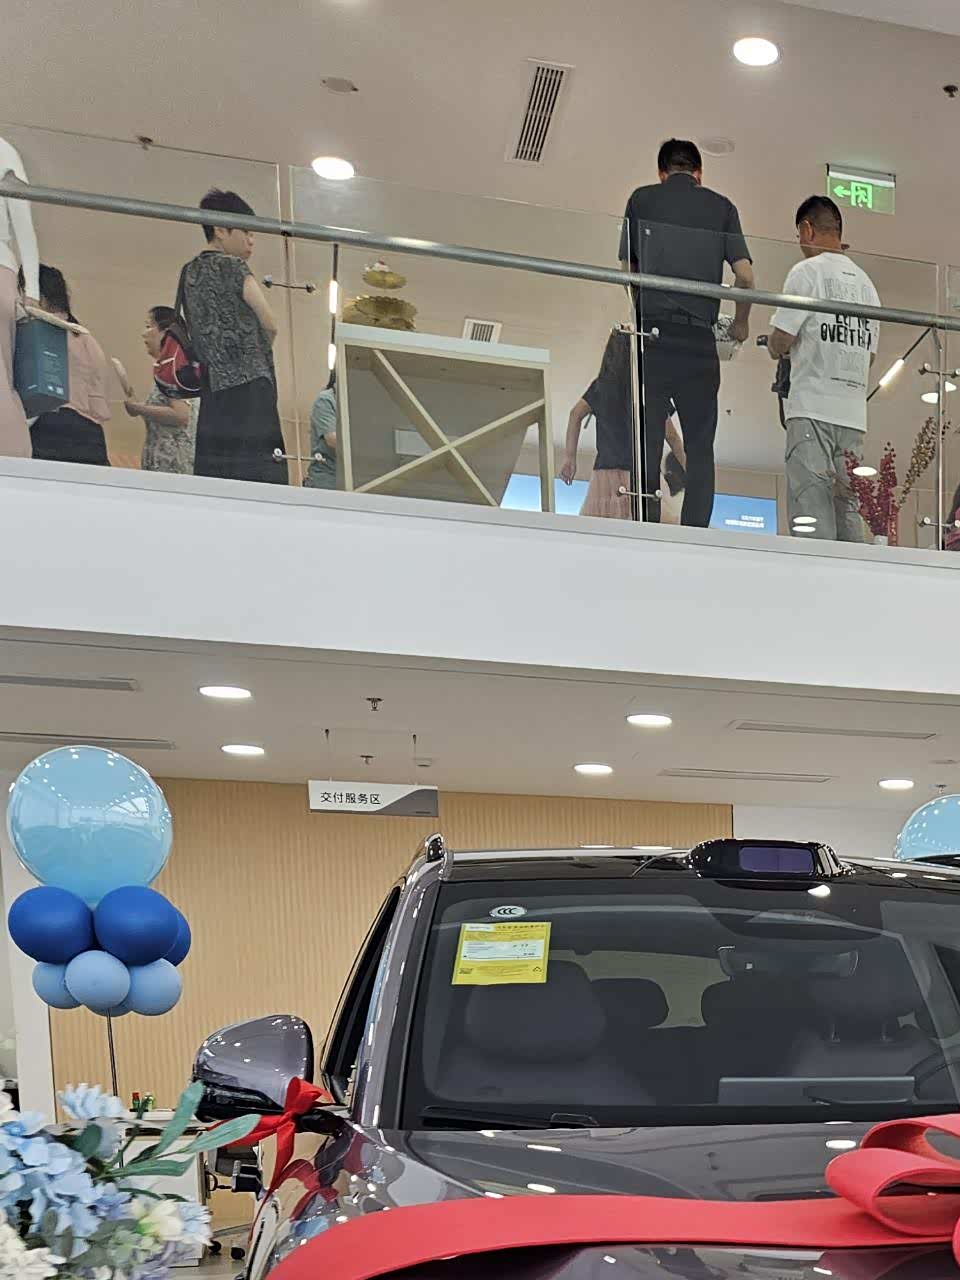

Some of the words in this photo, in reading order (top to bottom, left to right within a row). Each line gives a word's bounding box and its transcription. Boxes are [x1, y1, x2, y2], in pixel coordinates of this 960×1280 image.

[320, 791, 381, 805] 交付服务区
